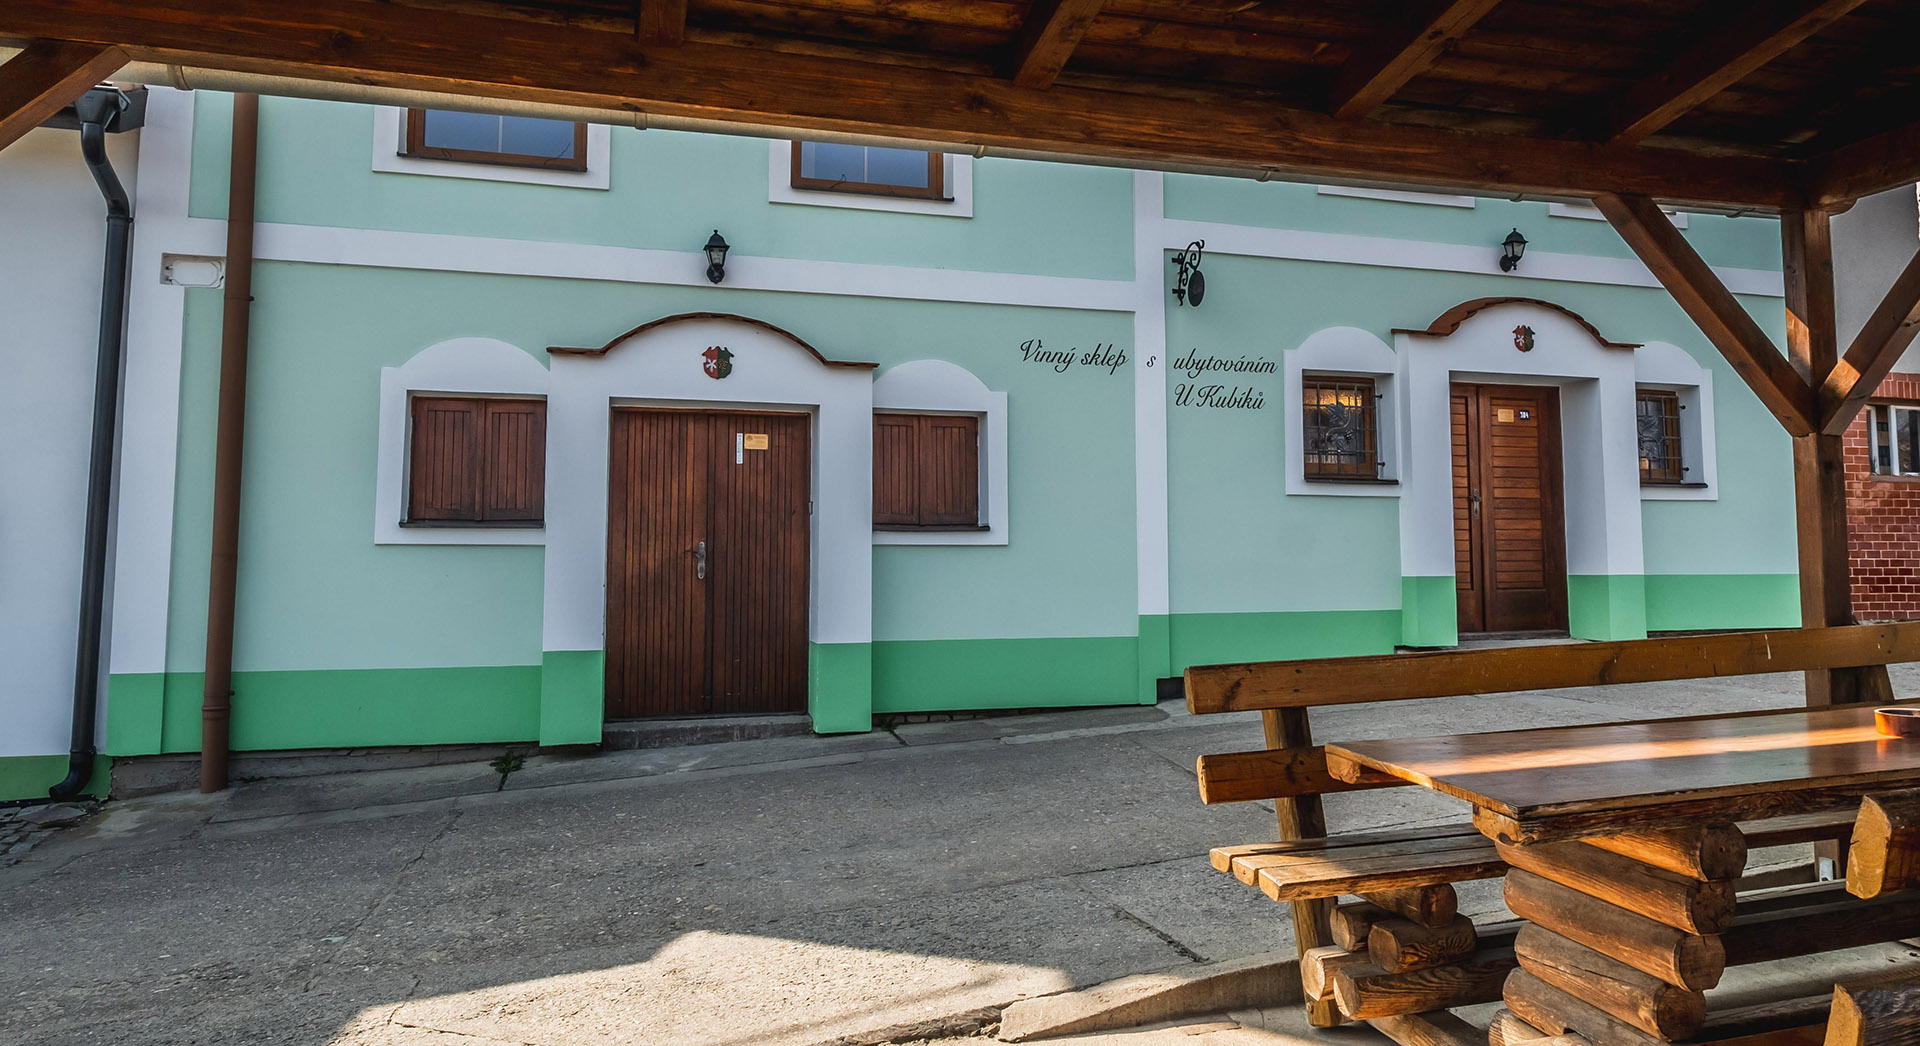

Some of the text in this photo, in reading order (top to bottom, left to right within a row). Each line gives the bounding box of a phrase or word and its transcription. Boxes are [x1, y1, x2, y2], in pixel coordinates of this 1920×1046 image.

[1020, 339, 1278, 379] Vinný sklep s ubytováním
[1174, 383, 1266, 410] U Kubíků
